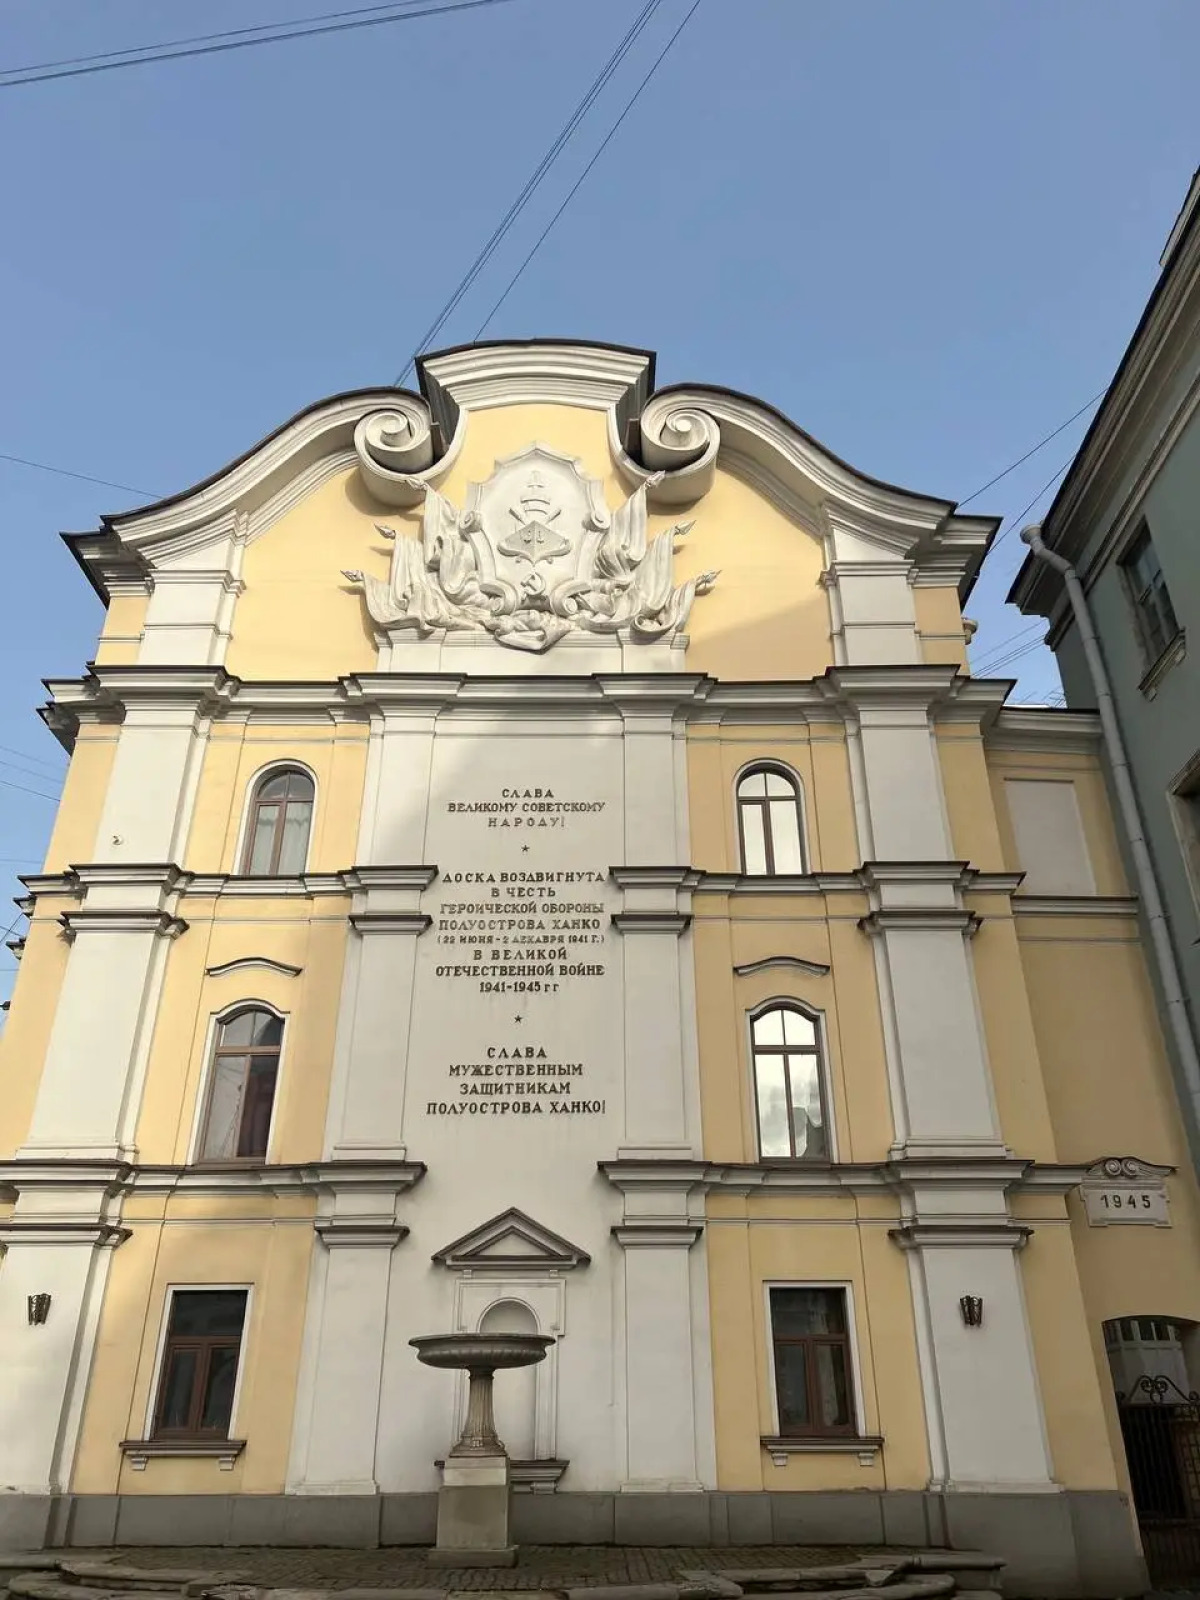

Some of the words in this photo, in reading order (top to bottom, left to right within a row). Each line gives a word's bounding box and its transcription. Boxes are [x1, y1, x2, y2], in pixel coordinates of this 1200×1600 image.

[502, 788, 554, 798] СЛАВА
[448, 803, 517, 812] ВЕЛИКОМУ
[522, 802, 605, 811] СОВЕТСКОМУ
[488, 817, 565, 827] НАРОДУ!
[442, 873, 495, 882] ДОСКА
[500, 872, 605, 882] ВОЗДВИГНУТА
[491, 888, 500, 897] В
[507, 887, 556, 897] ЧЕСТЬ
[440, 901, 537, 914] ГЕРОИЧЕСКОЙ
[542, 903, 603, 913] ОБОРОНЫ
[439, 919, 545, 931] ПОЛУОСТРОВА
[552, 919, 600, 929] ХАНКО
[460, 935, 493, 944] ИЮНЯ
[568, 935, 588, 943] 1941
[474, 950, 482, 960] В
[491, 947, 567, 960] ВЕЛИКОЙ
[436, 963, 554, 976] ОТЕЧЕСТВЕННОЙ
[559, 962, 605, 975] ВОЙНЕ
[480, 981, 540, 992] 1941-1945
[487, 1047, 547, 1058] СЛАВА
[449, 1064, 583, 1076] МУЖЕСТВЕННЫМ
[460, 1082, 570, 1095] ЗАЩИТНИКАМ
[426, 1102, 542, 1114] ПОЛУОСТРОВА
[550, 1100, 606, 1114] ХАНКО!
[1101, 1195, 1150, 1208] 1945
